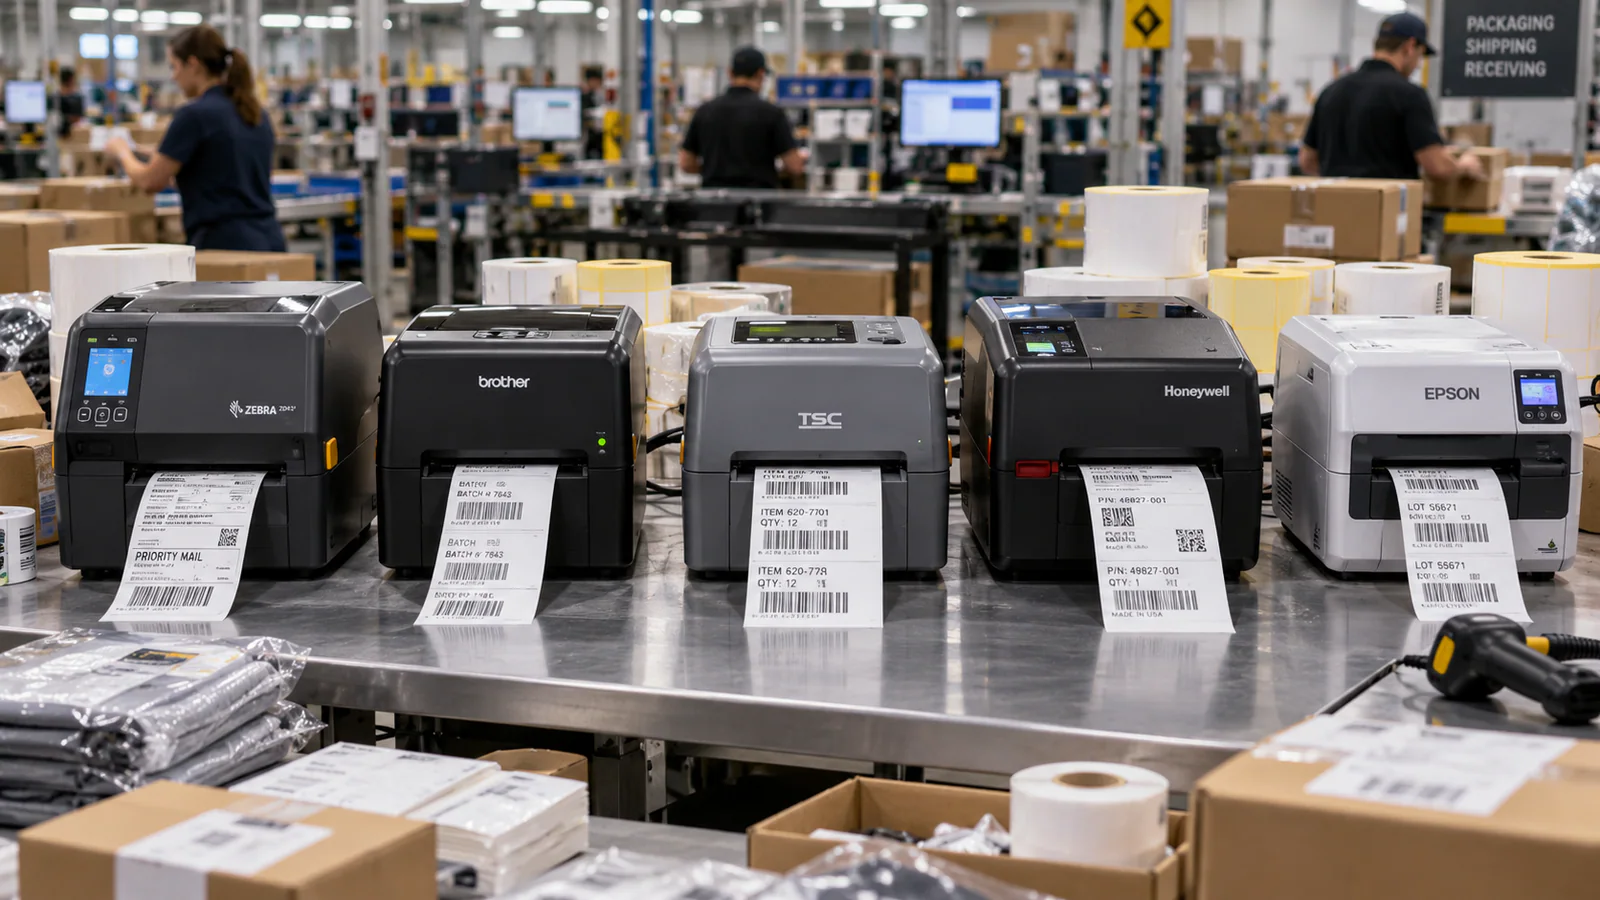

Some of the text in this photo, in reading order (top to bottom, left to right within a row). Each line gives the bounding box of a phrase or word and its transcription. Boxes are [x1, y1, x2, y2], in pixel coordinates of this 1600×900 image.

[1466, 14, 1555, 32] PACKAGING
[1465, 37, 1537, 55] SHIPPING
[1464, 60, 1547, 77] RECEIVING
[478, 375, 530, 388] brother
[1164, 385, 1230, 399] Honeywell
[1424, 387, 1480, 400] EPSON
[244, 405, 277, 415] ZEBRA
[798, 412, 842, 426] TSC
[456, 490, 484, 498] BATCH
[760, 508, 829, 516] ITEM 620-7701
[1407, 503, 1425, 511] LOT
[760, 518, 798, 527] QTY: 12
[447, 538, 476, 547] BATCH
[134, 551, 203, 562] PRIORITY MAIL
[758, 566, 782, 575] ITEM
[1107, 566, 1128, 575] P/N:
[1415, 561, 1433, 570] LOT
[757, 578, 797, 589] QTY: 12
[1108, 578, 1140, 587] QTY: 1
